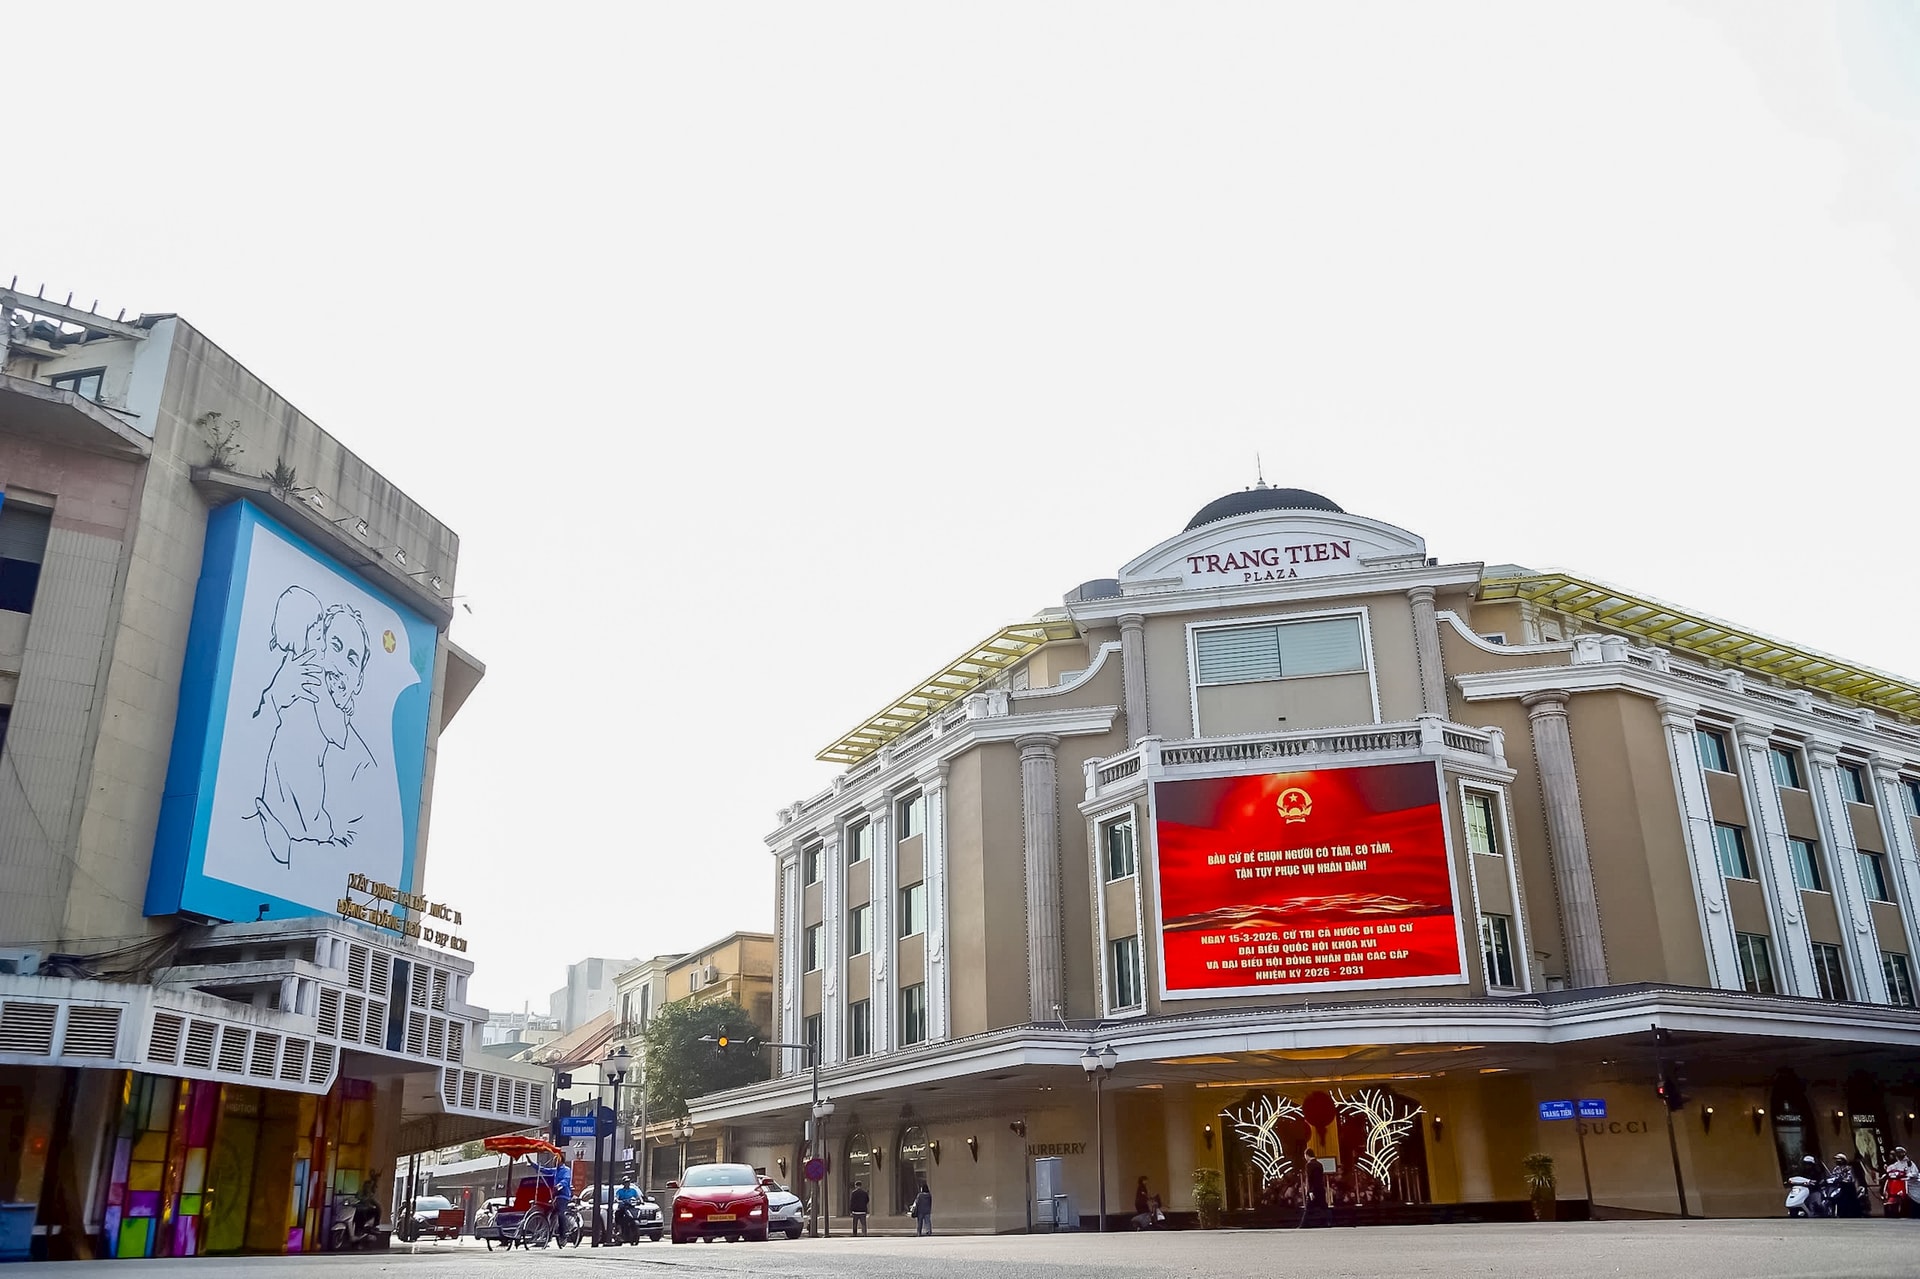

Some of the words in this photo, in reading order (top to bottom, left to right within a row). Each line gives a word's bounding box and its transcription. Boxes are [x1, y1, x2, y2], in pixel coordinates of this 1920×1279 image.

[1187, 549, 1280, 575] TRANG
[1284, 541, 1351, 563] TIEN
[1244, 567, 1298, 582] PLAZA
[1229, 852, 1241, 863] CỬ
[1257, 851, 1282, 862] CHỌN
[1235, 867, 1253, 880] TẬN
[1275, 865, 1299, 876] PHỤC
[1302, 864, 1314, 875] VỤ
[1317, 861, 1342, 873] NHÂN
[1283, 930, 1296, 939] CỬ
[1299, 930, 1314, 938] TRI
[1312, 941, 1328, 951] HỘI
[1361, 939, 1376, 947] XVI
[1266, 957, 1282, 966] HỘI
[1315, 954, 1341, 963] NHÂN
[1344, 952, 1363, 961] DÂN
[1256, 970, 1286, 979] NHIỆM
[1305, 968, 1329, 977] 2026
[1340, 966, 1363, 975] 2031
[1576, 1121, 1649, 1136] GUCCI
